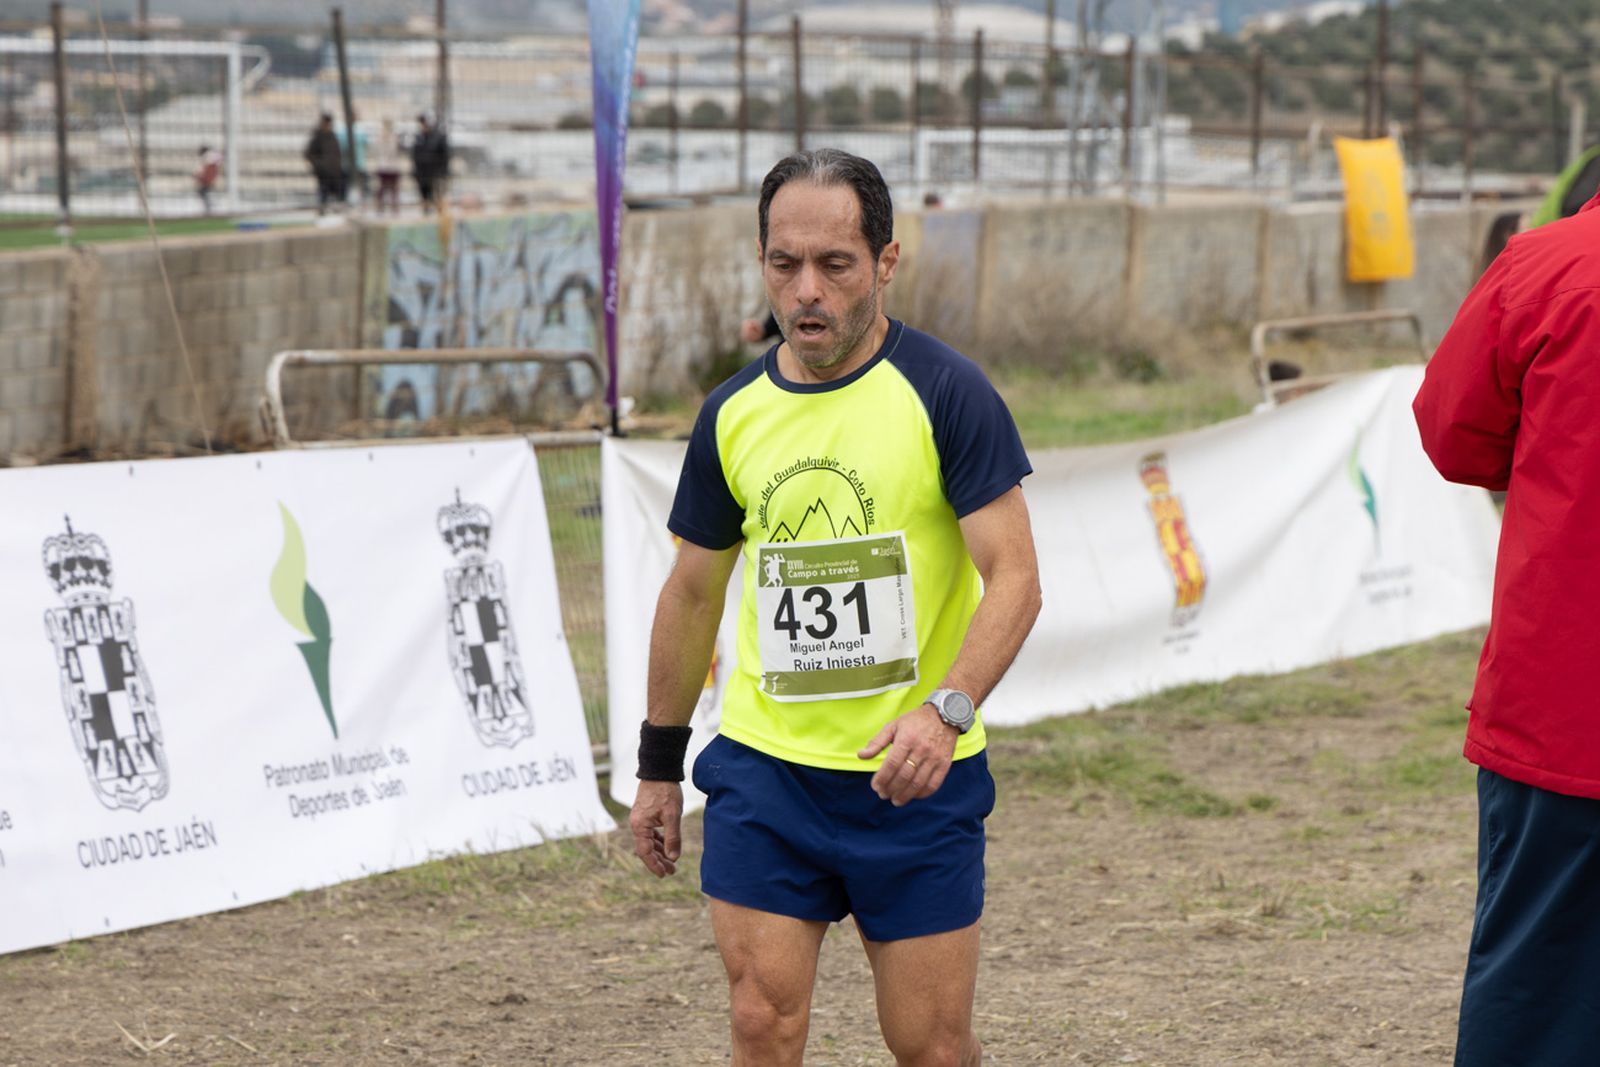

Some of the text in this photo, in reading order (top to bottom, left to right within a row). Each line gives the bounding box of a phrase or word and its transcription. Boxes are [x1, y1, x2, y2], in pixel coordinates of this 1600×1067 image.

[761, 482, 774, 500] del
[774, 456, 839, 482] Guadalquivir
[848, 469, 866, 496] Coto
[787, 570, 818, 579] Campo
[829, 565, 860, 576] través
[774, 581, 871, 641] 431
[790, 638, 864, 655] Miguel Angel
[794, 654, 875, 672] Ruiz Iniesta
[263, 759, 329, 788] Patronato
[390, 745, 410, 764] de
[462, 767, 518, 798] CIUDAD
[519, 762, 543, 788] DE
[288, 790, 349, 820] Deportes
[352, 784, 370, 806] de
[77, 815, 218, 868] CIUDAD DE JAÉN
